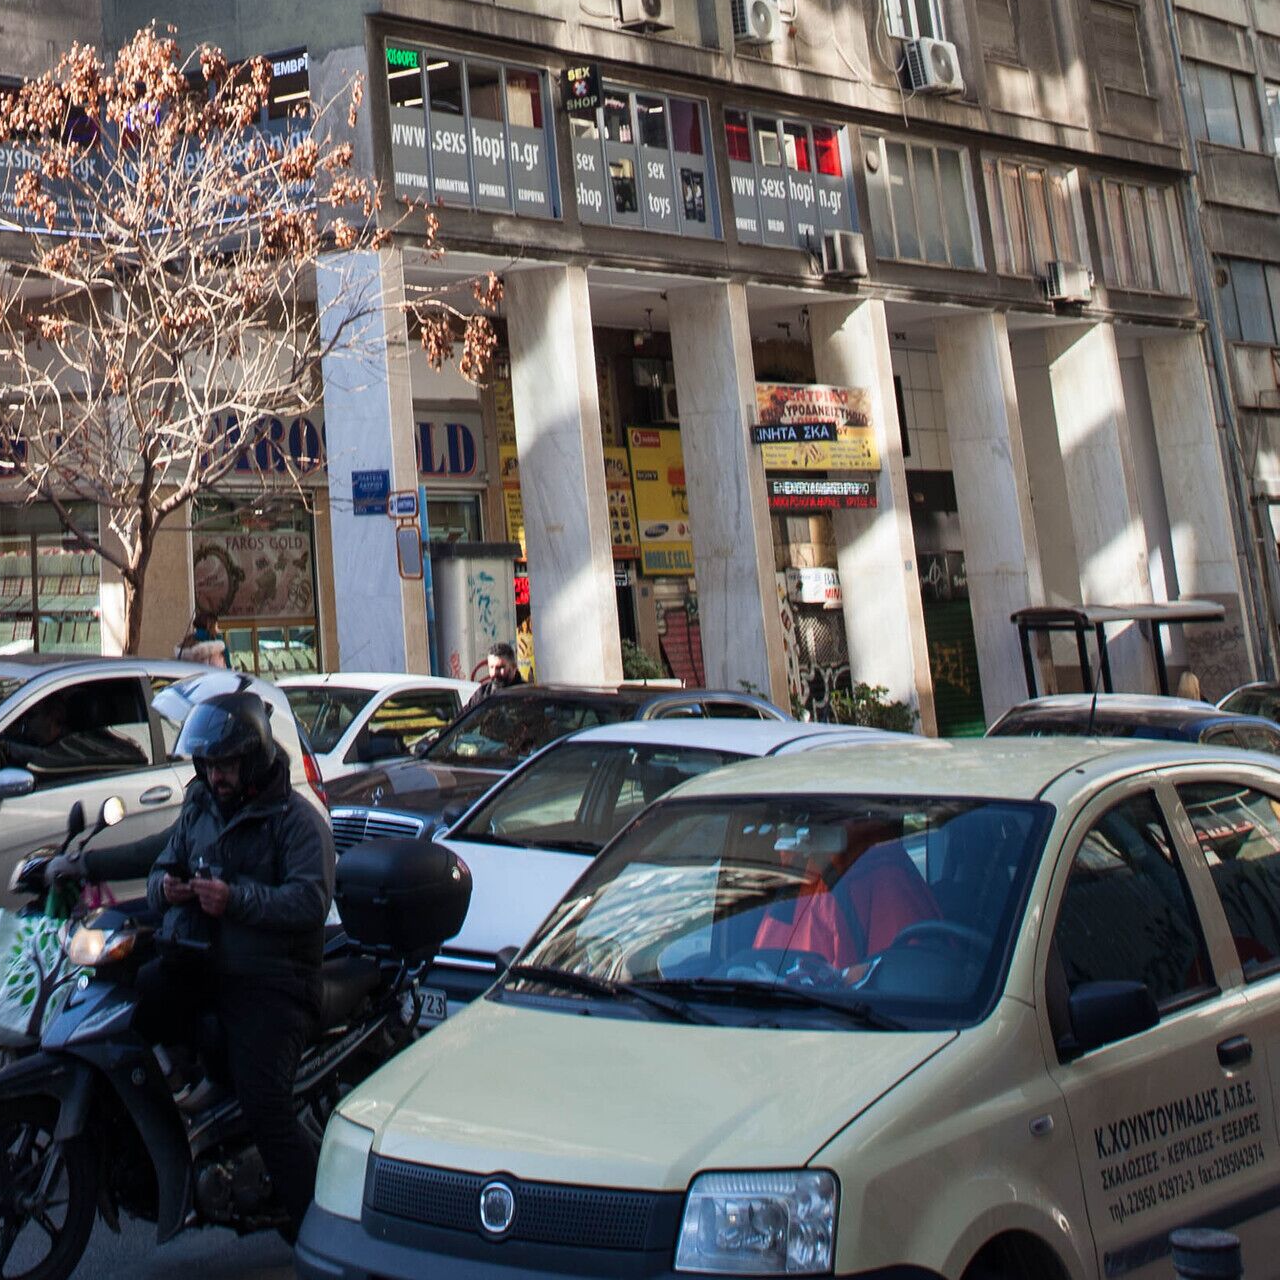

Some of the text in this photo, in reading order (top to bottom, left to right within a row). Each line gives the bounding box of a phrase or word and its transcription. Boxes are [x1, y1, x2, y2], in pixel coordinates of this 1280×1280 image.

[567, 66, 591, 81] SEX
[566, 95, 598, 111] SHOP
[392, 123, 539, 171] www.sexshopin.gr
[576, 152, 595, 172] sex
[647, 161, 665, 180] sex
[577, 183, 602, 212] shop
[648, 192, 671, 219] toys
[804, 425, 830, 440] ΣΚΑ
[225, 535, 303, 550] FAROS GOLD
[1094, 1088, 1221, 1159] Κ.ΧΟΥΝΤΟΥΜΑΔΗΣ
[1101, 1113, 1261, 1191] ΣΚΑΛΩΣΙΕΣ ΚΕΡΚΙΔΕΣ ΕΞΕΔΡΕΣ
